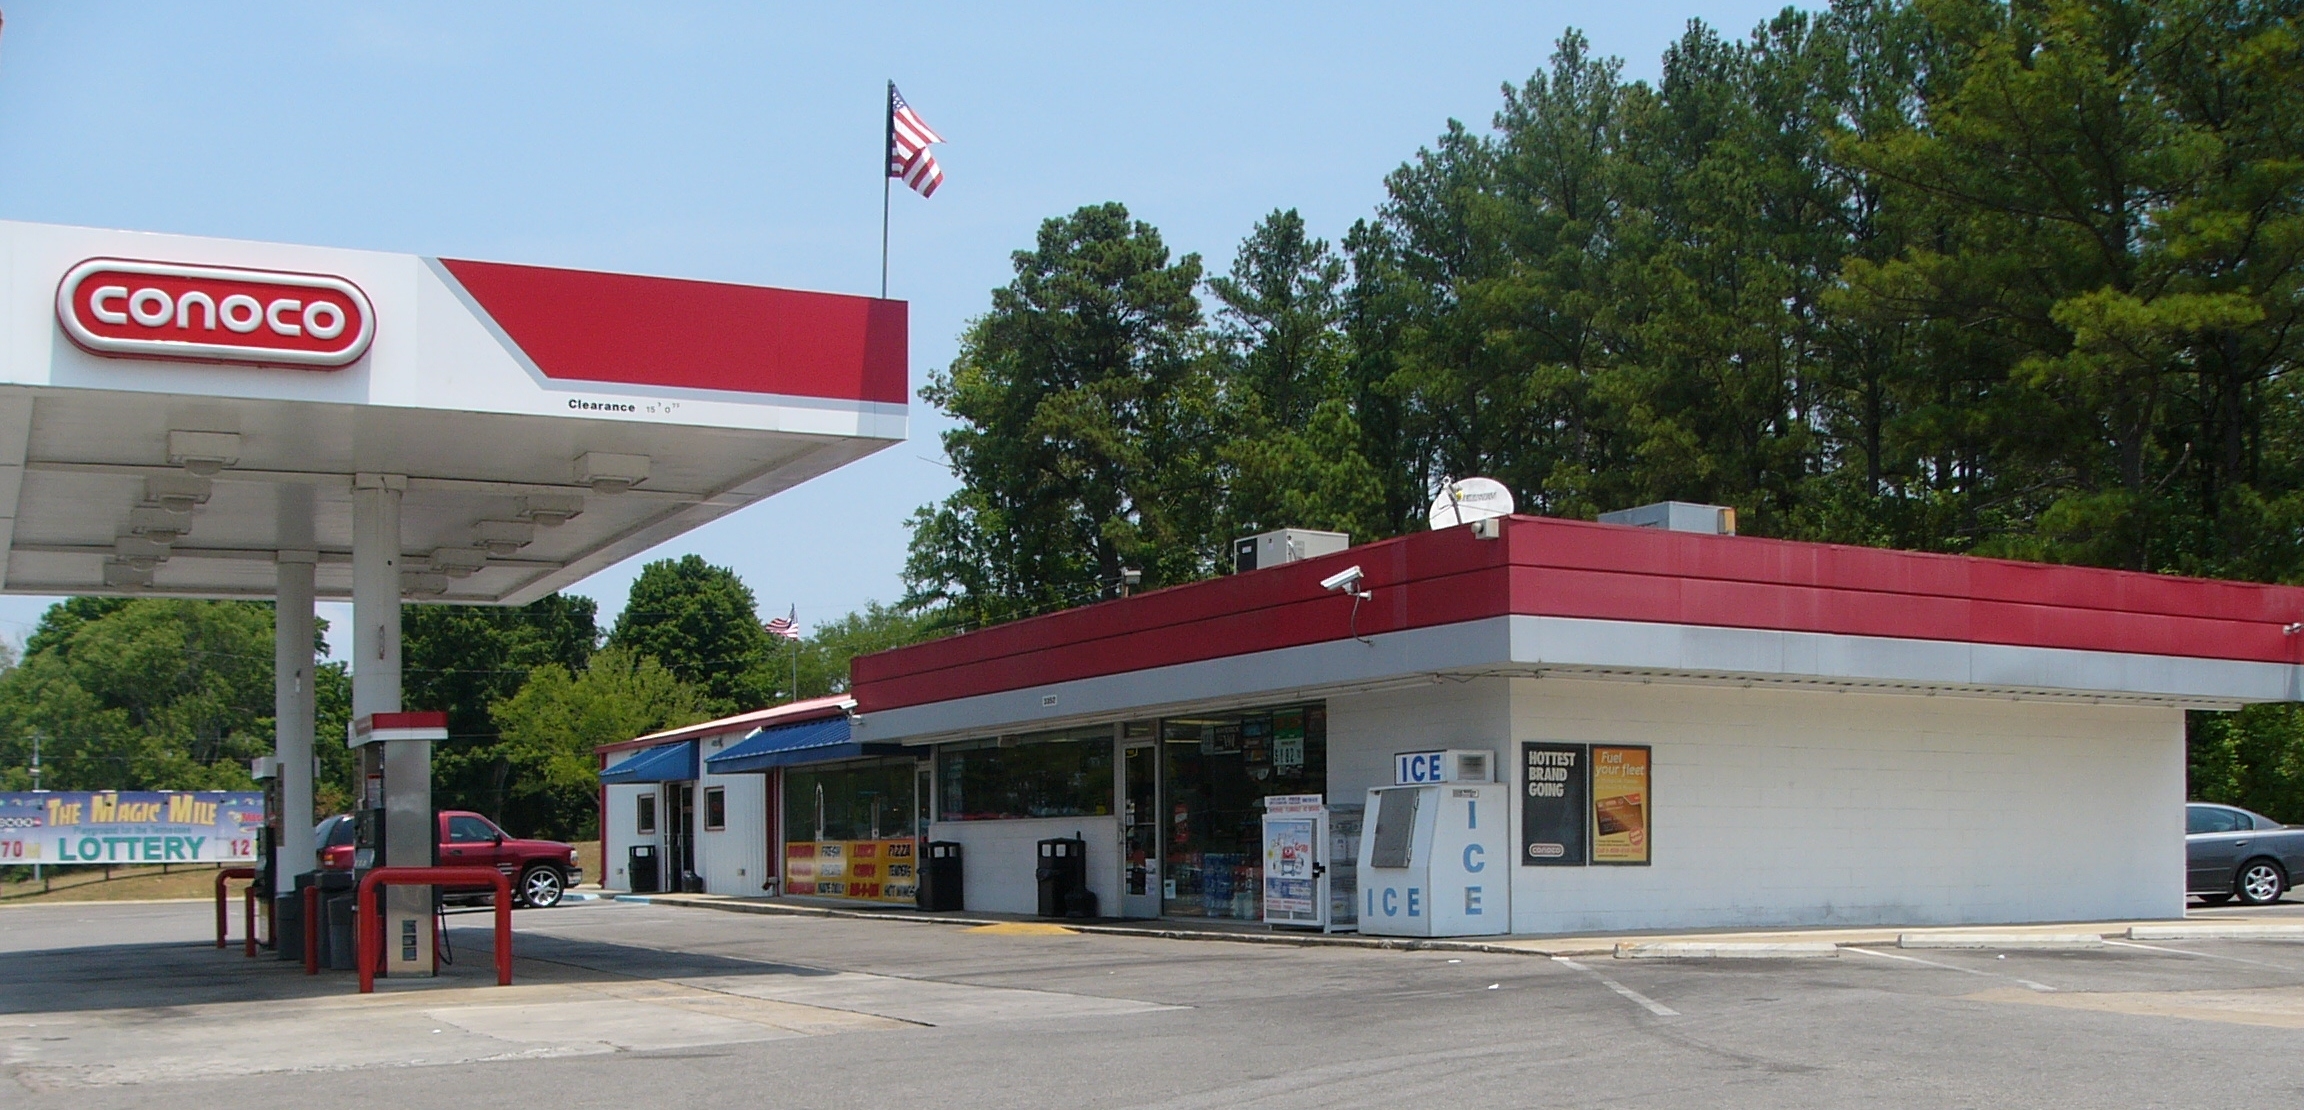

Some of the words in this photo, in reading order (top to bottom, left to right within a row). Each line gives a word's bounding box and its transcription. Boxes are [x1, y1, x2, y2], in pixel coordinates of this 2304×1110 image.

[568, 399, 636, 412] Clearance
[1528, 751, 1576, 767] HOTTEST
[1601, 752, 1622, 764] Fuel
[1402, 755, 1441, 782] ICE
[1528, 767, 1567, 781] BRAND
[1595, 766, 1618, 778] your
[1622, 764, 1645, 777] fleet
[1528, 782, 1564, 798] GOING
[46, 797, 82, 827] THE
[90, 794, 162, 823] MAGIC
[168, 793, 218, 826] MILE
[58, 836, 206, 861] LOTTERY
[230, 839, 250, 856] 12
[888, 844, 911, 857] PIZZA
[1462, 800, 1485, 915] ICE
[1367, 887, 1421, 917] ICE
